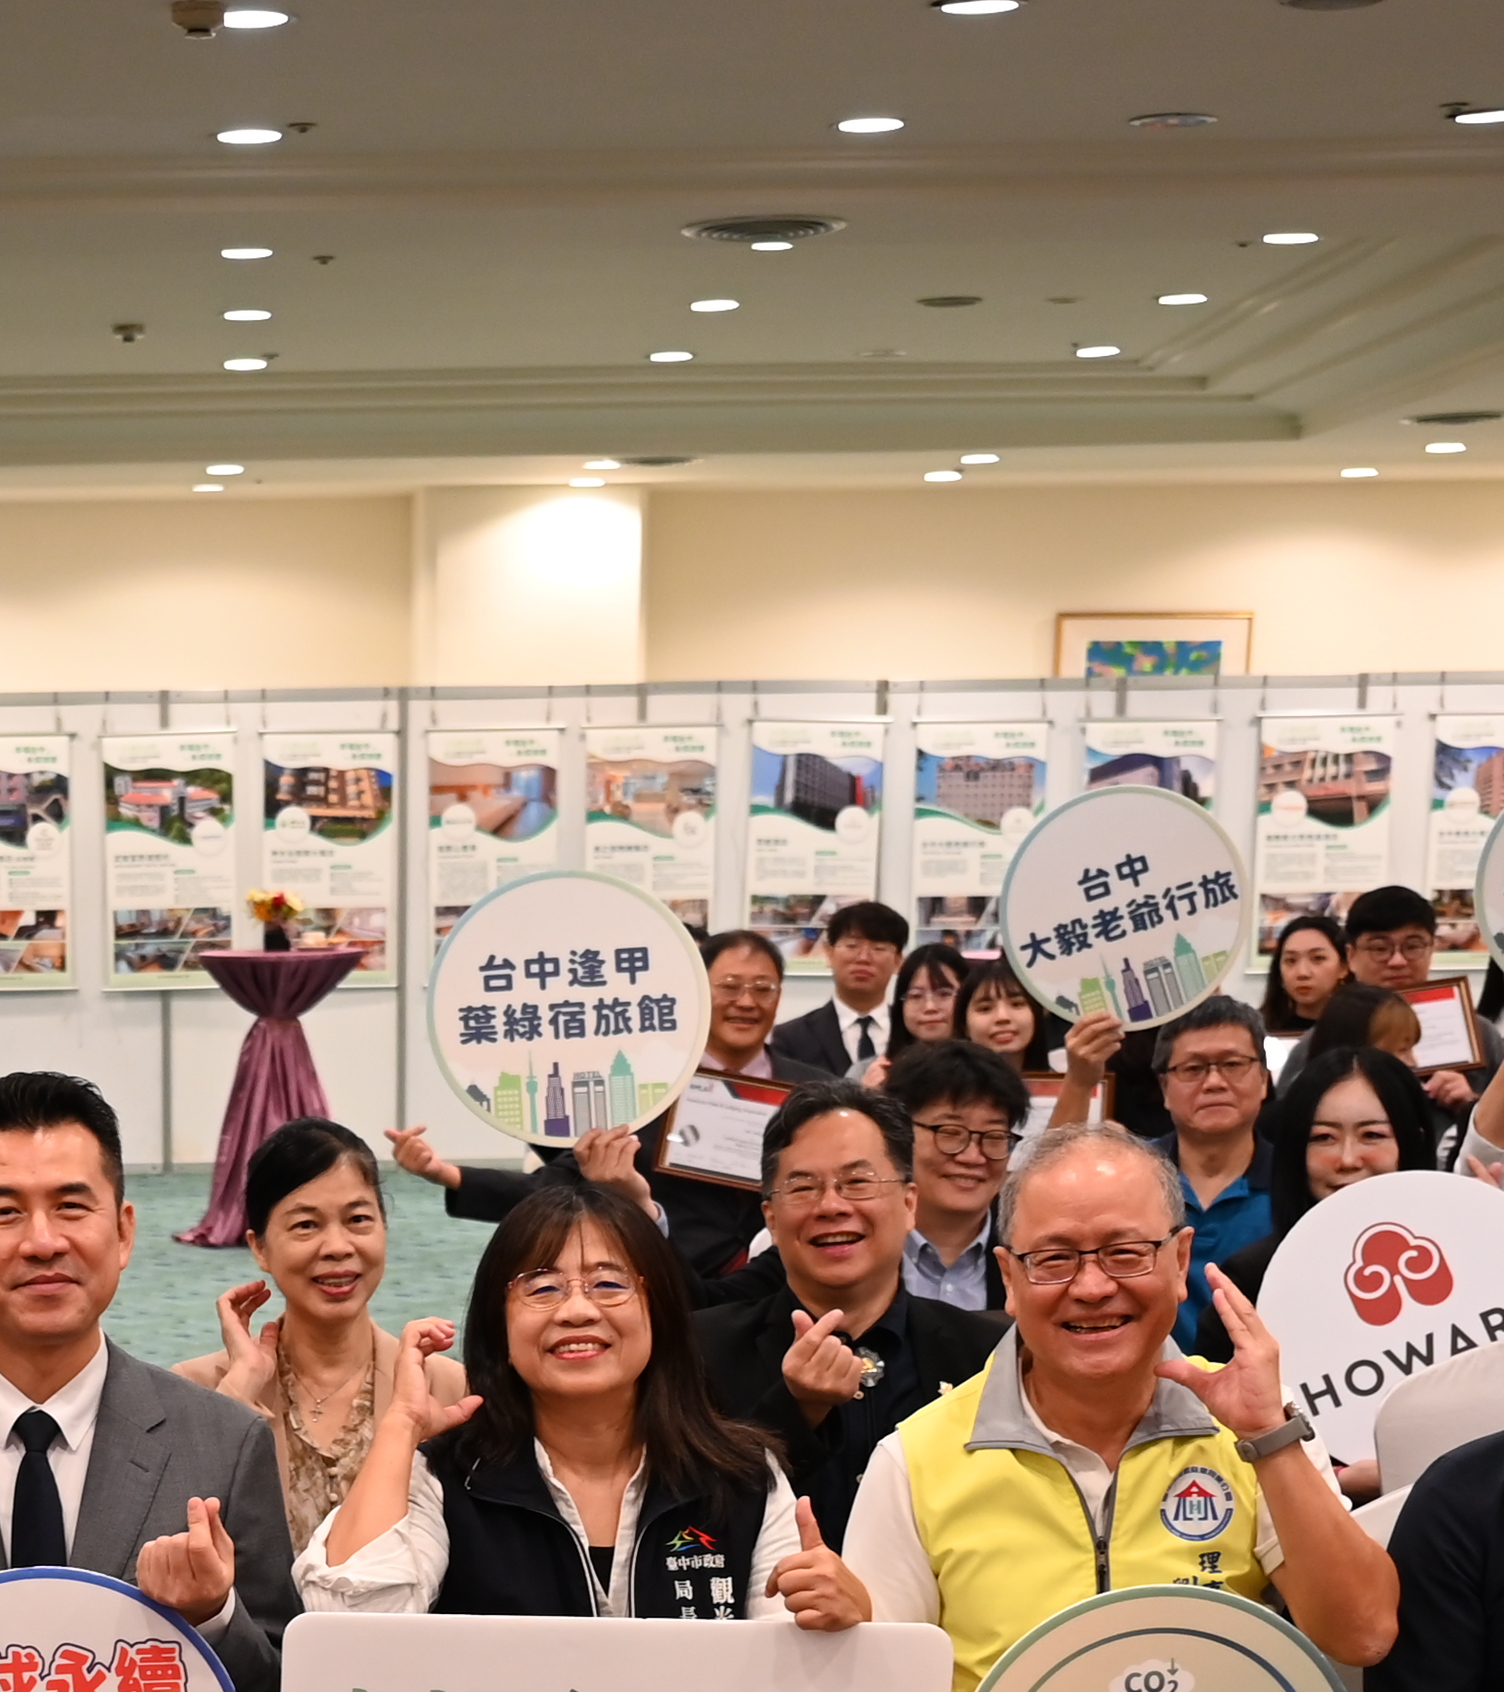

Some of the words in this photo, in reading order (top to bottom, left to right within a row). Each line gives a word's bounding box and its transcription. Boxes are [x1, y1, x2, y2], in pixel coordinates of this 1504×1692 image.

[1077, 853, 1150, 903] 台中
[1020, 870, 1239, 969] 大毅老爺行旅
[478, 946, 650, 993] 台中逢甲
[458, 993, 678, 1045] 葉綠宿旅館
